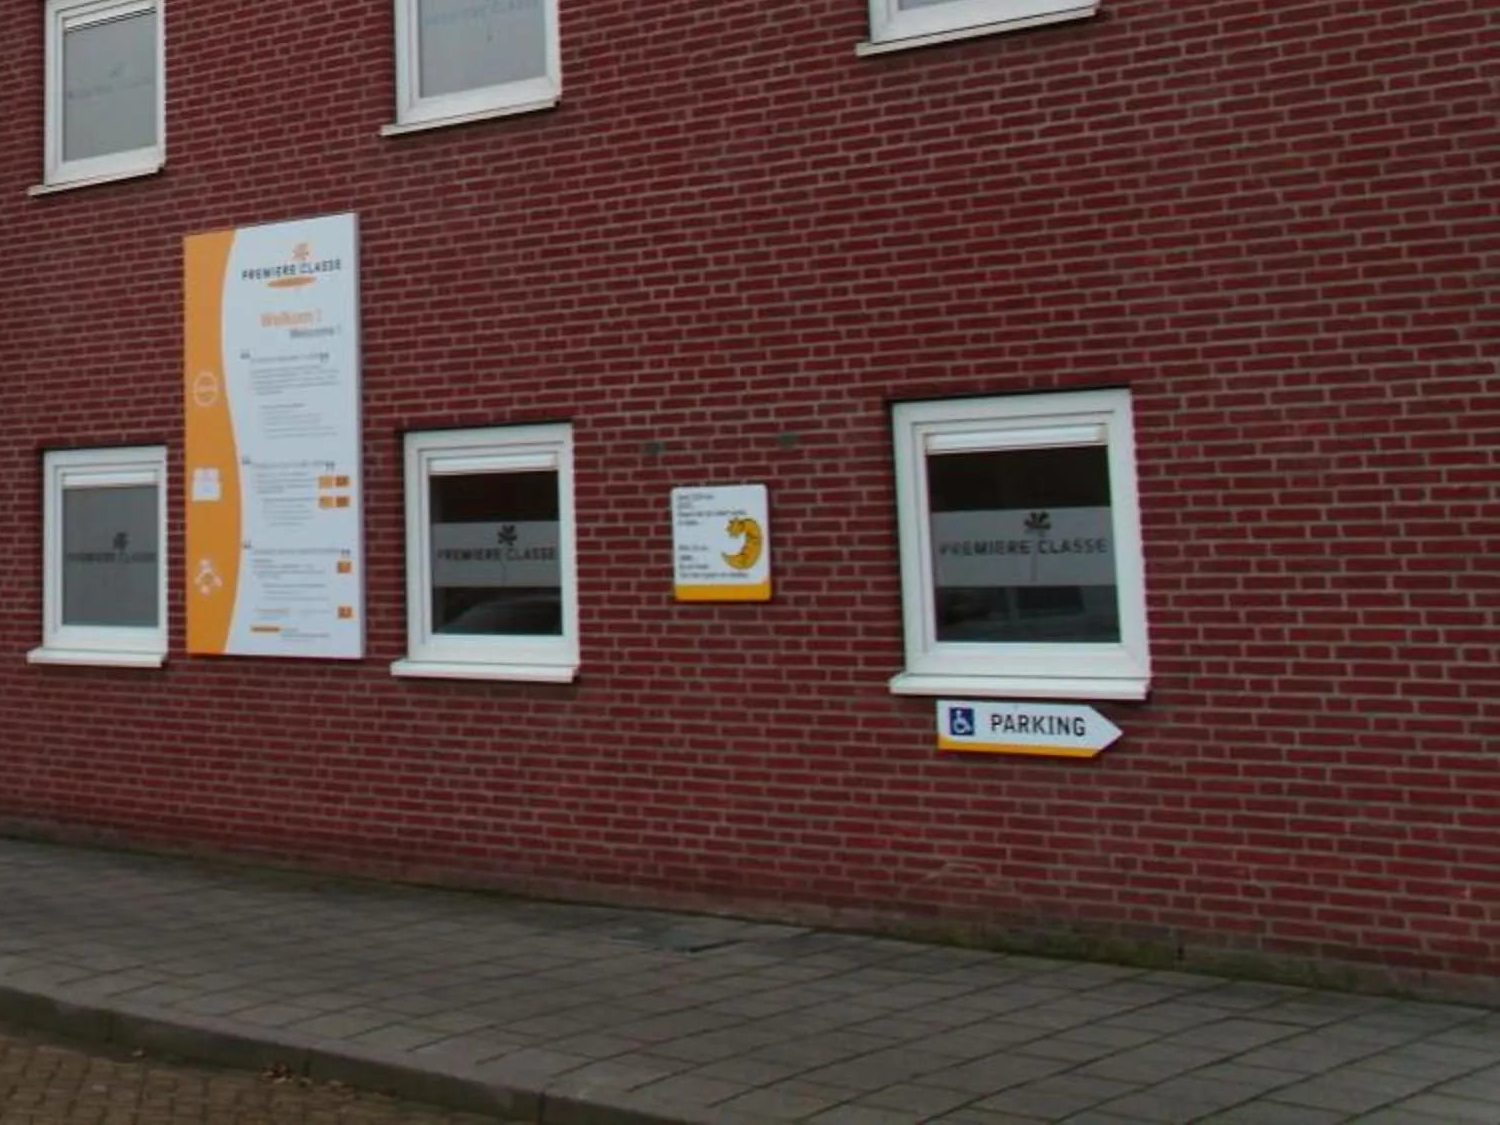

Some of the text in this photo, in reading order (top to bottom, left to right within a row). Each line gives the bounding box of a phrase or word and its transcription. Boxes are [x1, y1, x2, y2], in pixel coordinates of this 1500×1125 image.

[939, 537, 1108, 557] PREMIERE CLASSE
[990, 713, 1087, 737] PARKING
